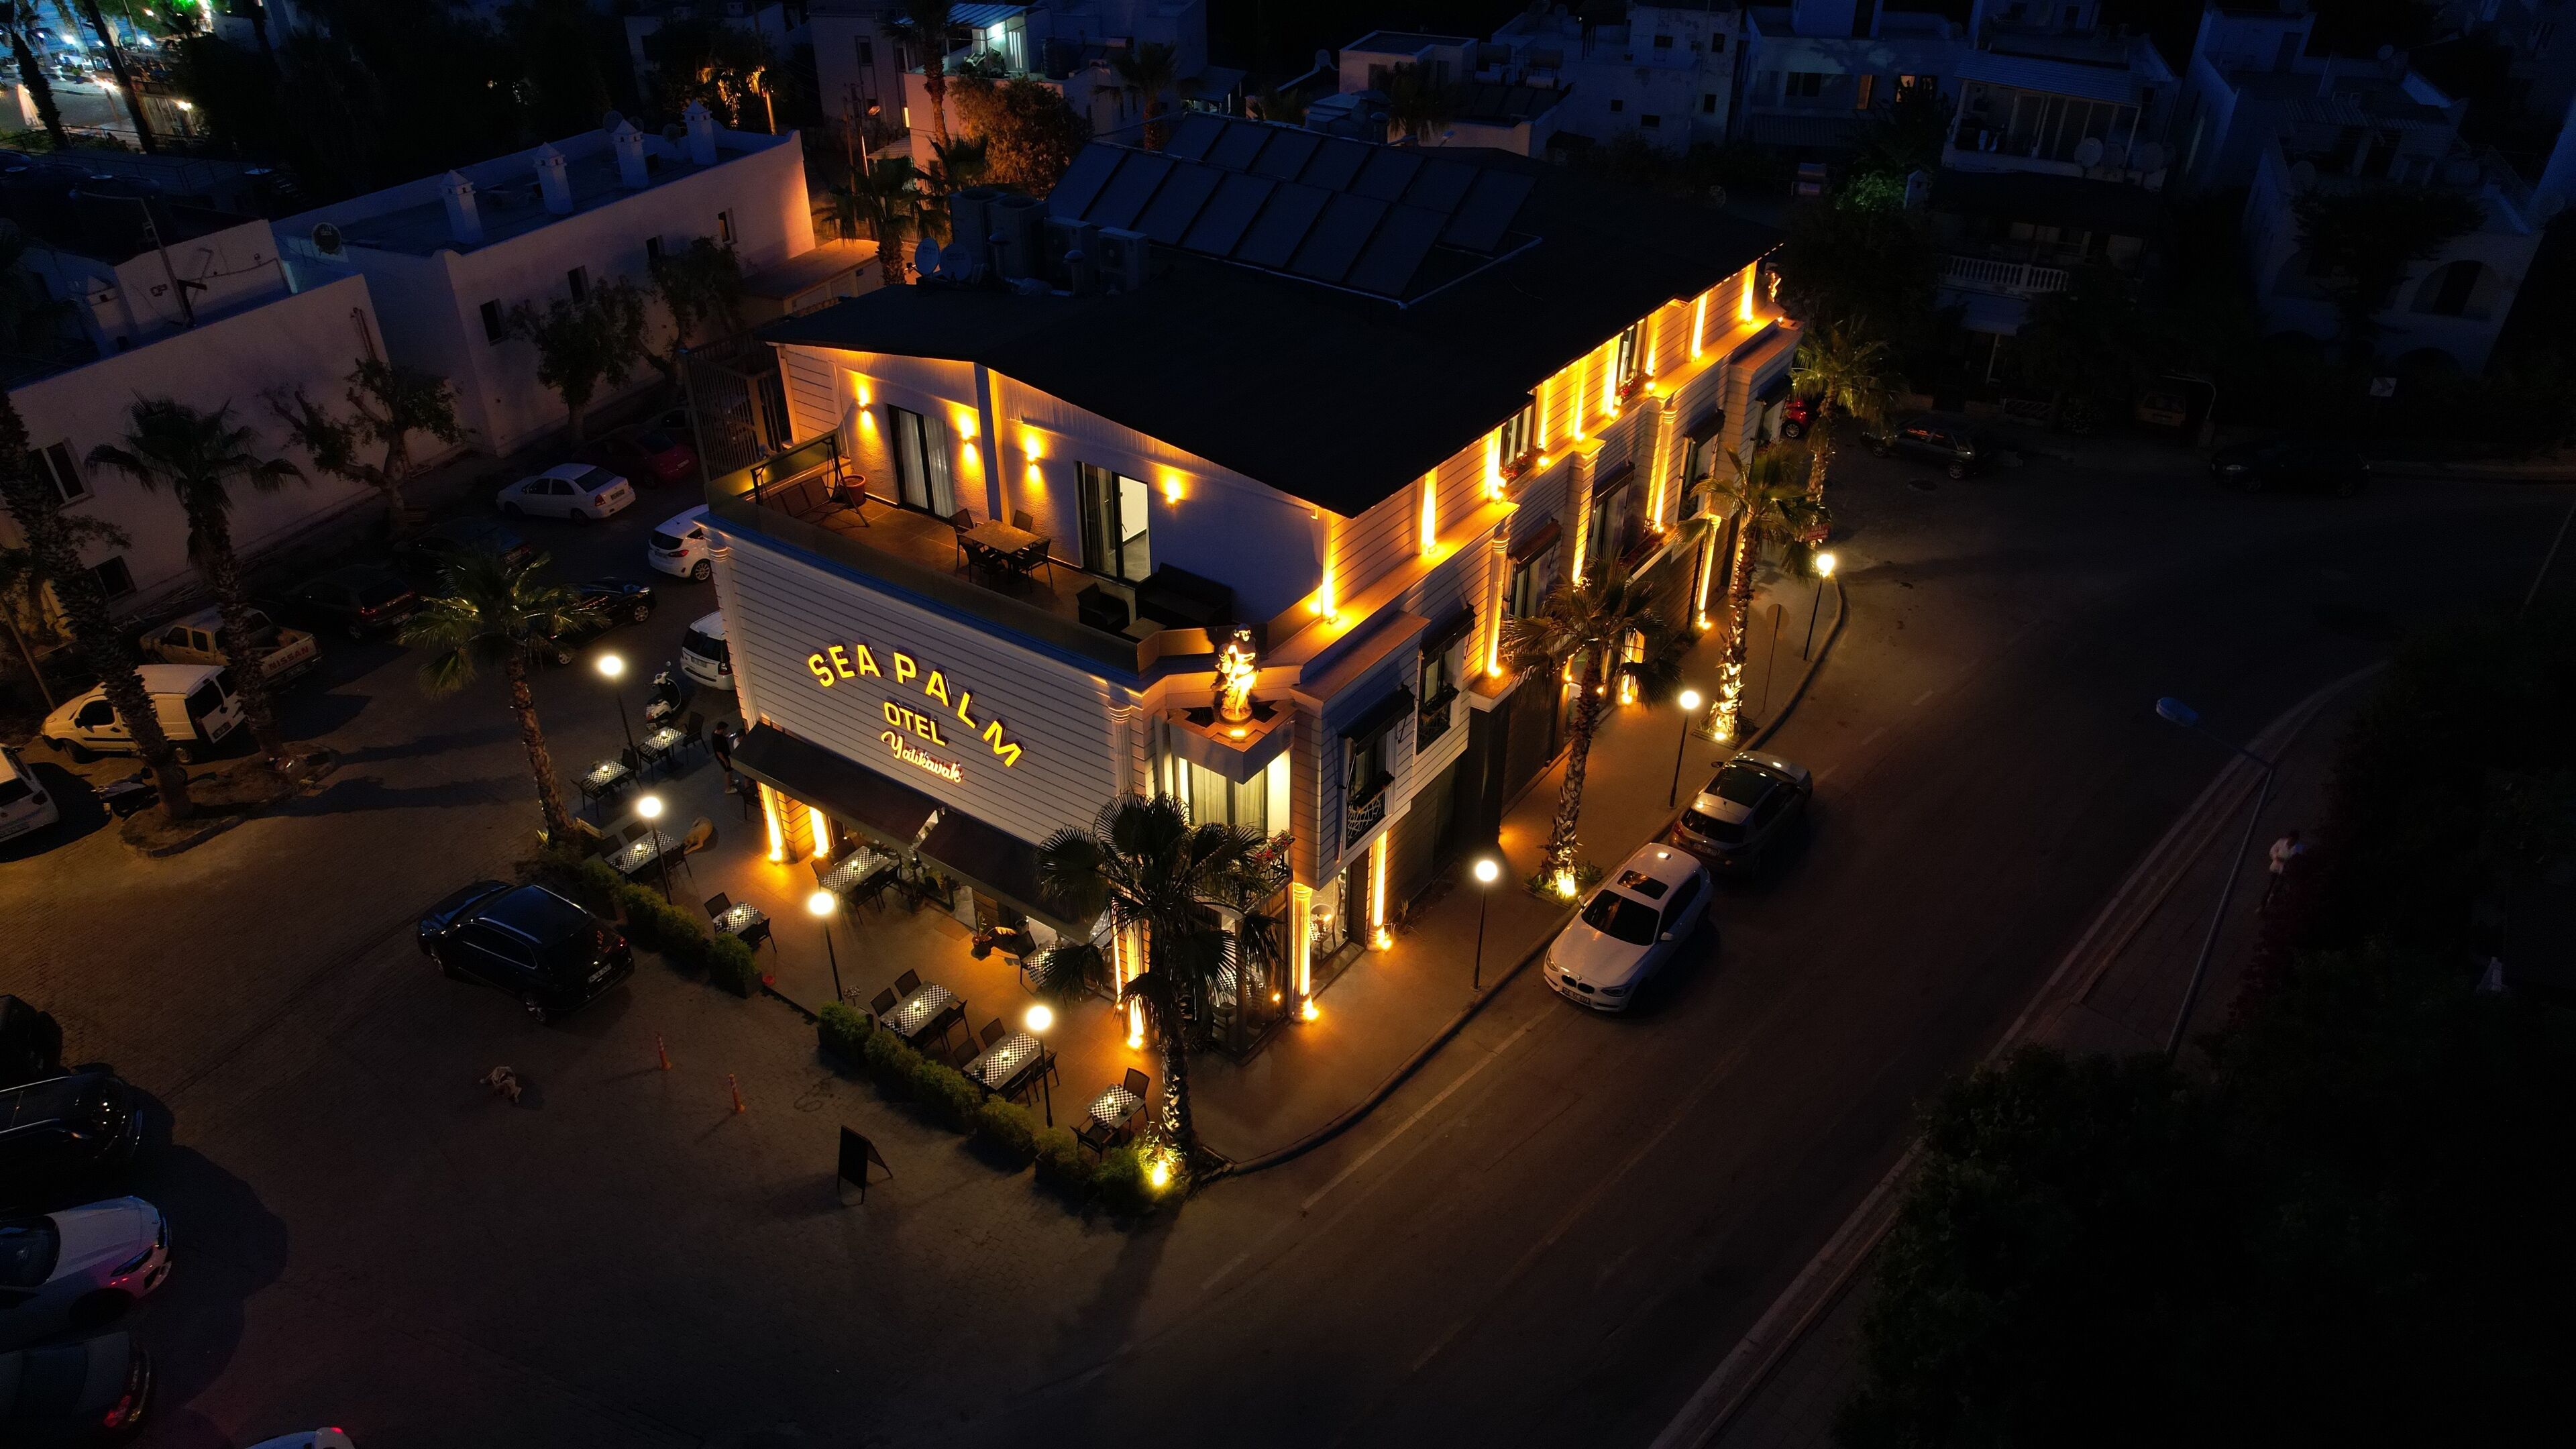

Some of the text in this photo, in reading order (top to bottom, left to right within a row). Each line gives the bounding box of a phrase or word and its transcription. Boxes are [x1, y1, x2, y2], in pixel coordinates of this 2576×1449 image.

[269, 646, 309, 670] NISSAN
[808, 643, 1024, 767] SEA PALM
[883, 700, 947, 746] OTEL
